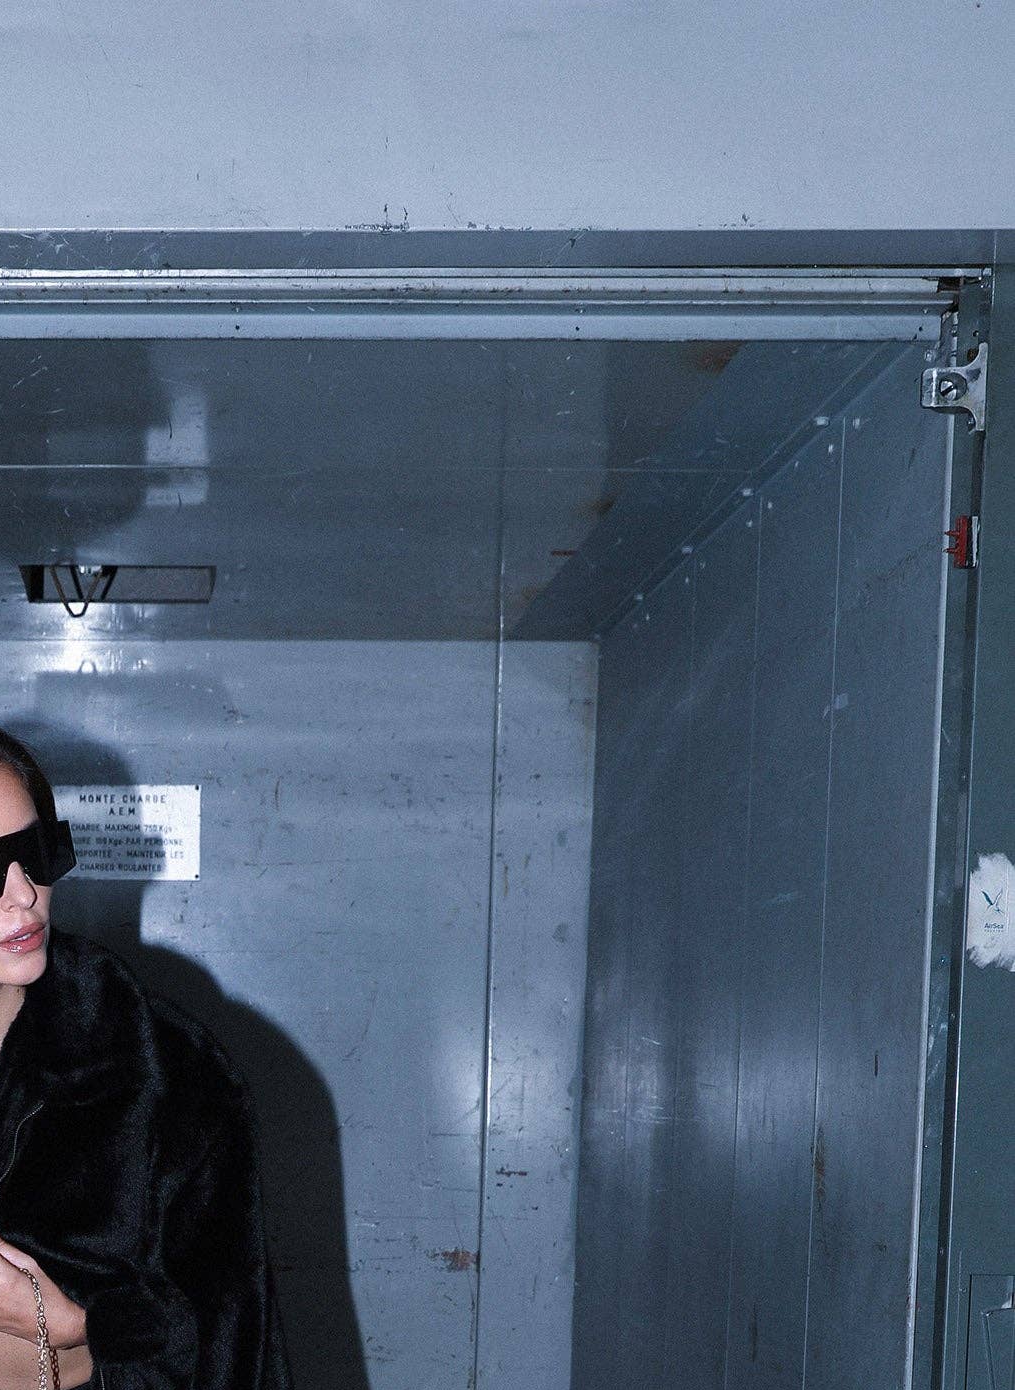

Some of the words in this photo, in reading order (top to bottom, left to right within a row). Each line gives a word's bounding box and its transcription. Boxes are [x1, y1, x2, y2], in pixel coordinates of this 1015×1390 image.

[79, 794, 116, 803] MONTE
[104, 823, 141, 832] MAXIMUM
[143, 837, 184, 846] PERSONNE
